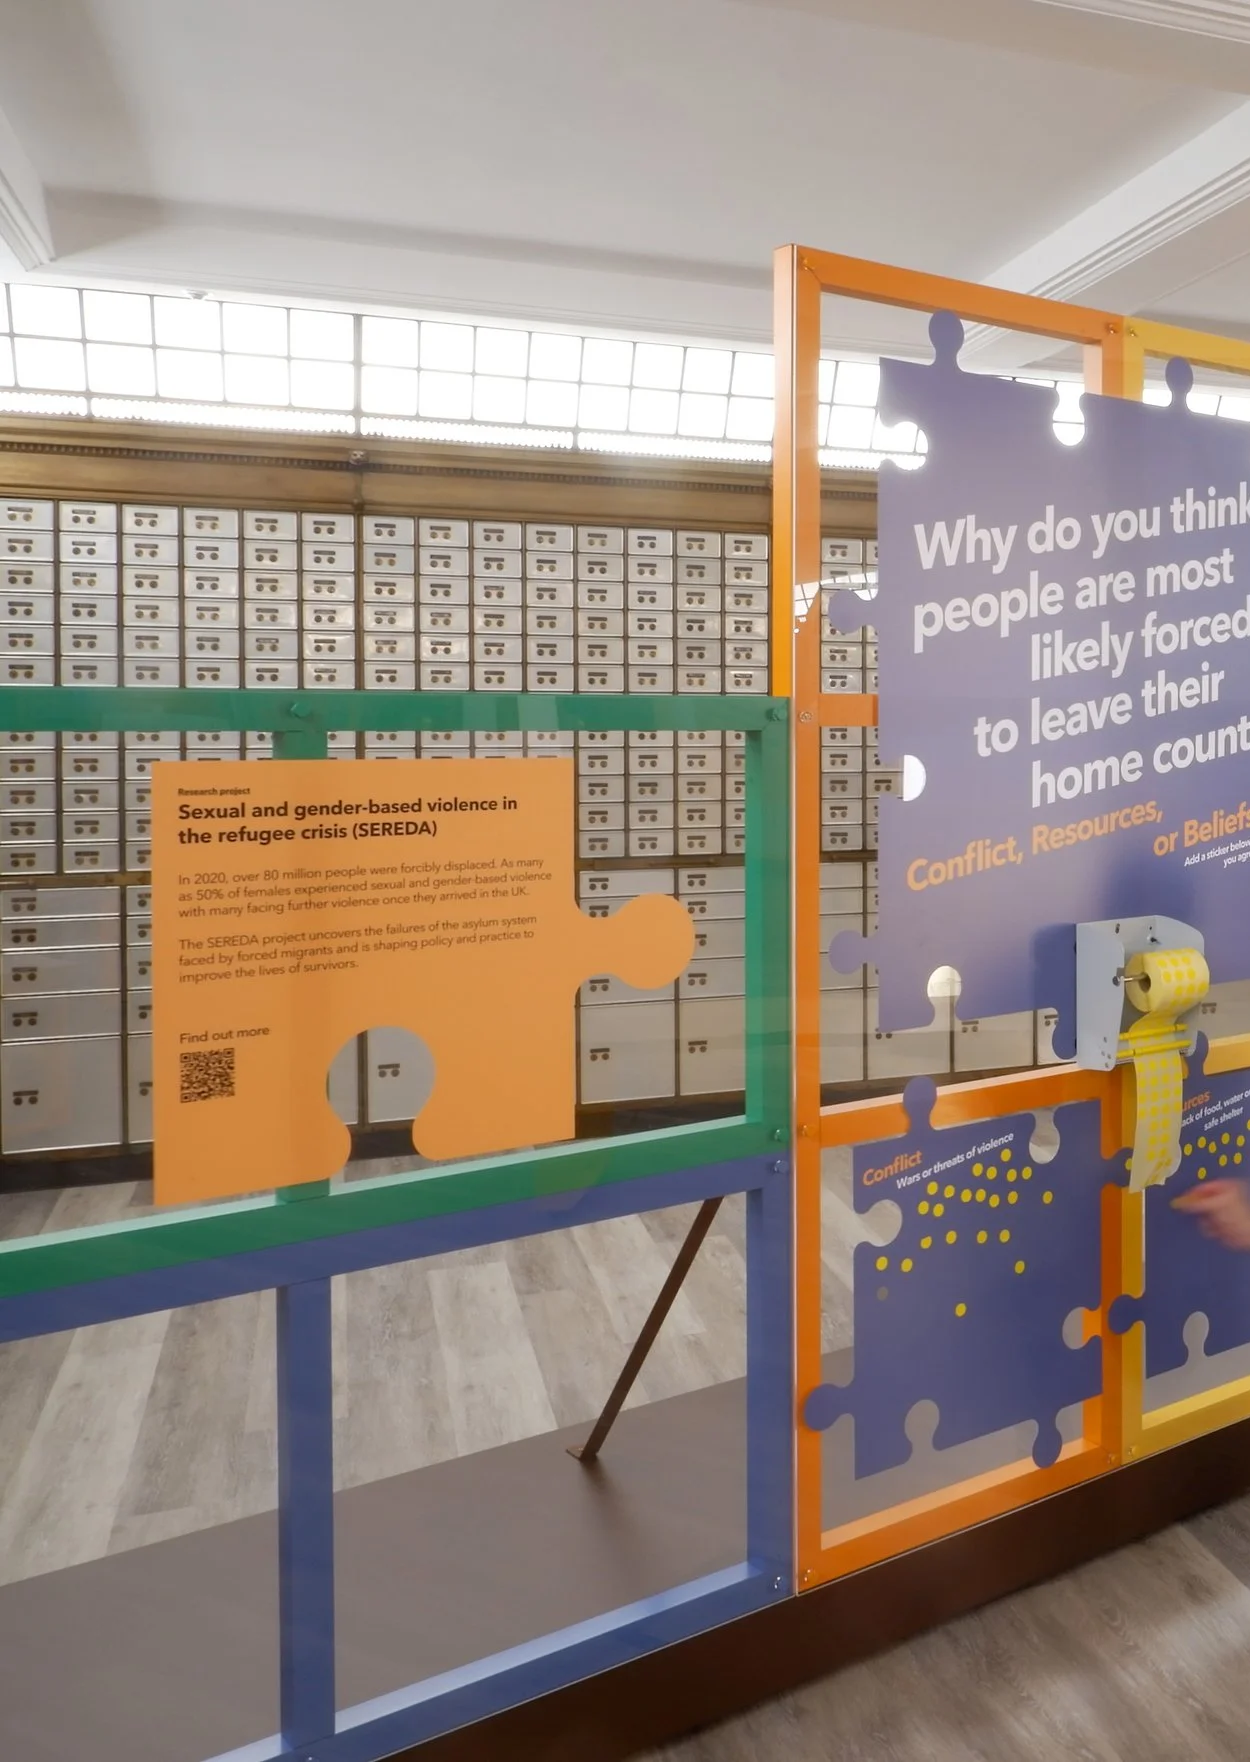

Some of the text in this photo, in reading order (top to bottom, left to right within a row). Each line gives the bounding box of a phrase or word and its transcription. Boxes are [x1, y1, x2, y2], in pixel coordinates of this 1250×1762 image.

[914, 514, 1018, 575] Why
[1027, 505, 1081, 554] do
[1091, 507, 1161, 559] you
[913, 548, 1235, 654] people are most
[1031, 621, 1134, 681] likely
[973, 662, 1225, 758] to leave their
[178, 787, 250, 797] Research project
[1031, 750, 1143, 808] home
[178, 796, 517, 821] Sexual and gender-based violence in
[178, 820, 437, 845] the refugee crisis (SEREDA)
[907, 836, 1024, 892] Conflict,
[1031, 800, 1163, 855] Resources,
[1153, 831, 1179, 857] or
[178, 858, 544, 885] In 2020, over 80 million people were forcibly displaced. As many
[1184, 854, 1200, 867] Add
[1200, 852, 1206, 861] a
[1206, 845, 1230, 860] sticker
[1223, 856, 1236, 868] you
[178, 893, 193, 902] as
[196, 888, 225, 901] 50%
[227, 887, 240, 899] of
[243, 886, 291, 898] females
[294, 881, 368, 896] experienced
[371, 879, 406, 890] sexual
[408, 877, 430, 888] and
[509, 871, 552, 882] violence
[178, 886, 530, 918] with many facing further violence once they arrived in the UK.
[179, 916, 537, 950] The SEREDA project uncovers the failures of the asylum system
[179, 930, 535, 966] faced by forced migrants and is shaping policy and practice to
[179, 960, 359, 985] improve the lives of survivors.
[179, 1027, 270, 1044] Find out more
[1195, 1109, 1203, 1121] of
[1204, 1101, 1223, 1116] food,
[1223, 1092, 1244, 1107] water
[1204, 1107, 1244, 1131] safe shelter
[862, 1150, 923, 1186] Conflict
[896, 1132, 1014, 1189] Wars or threats of violence
